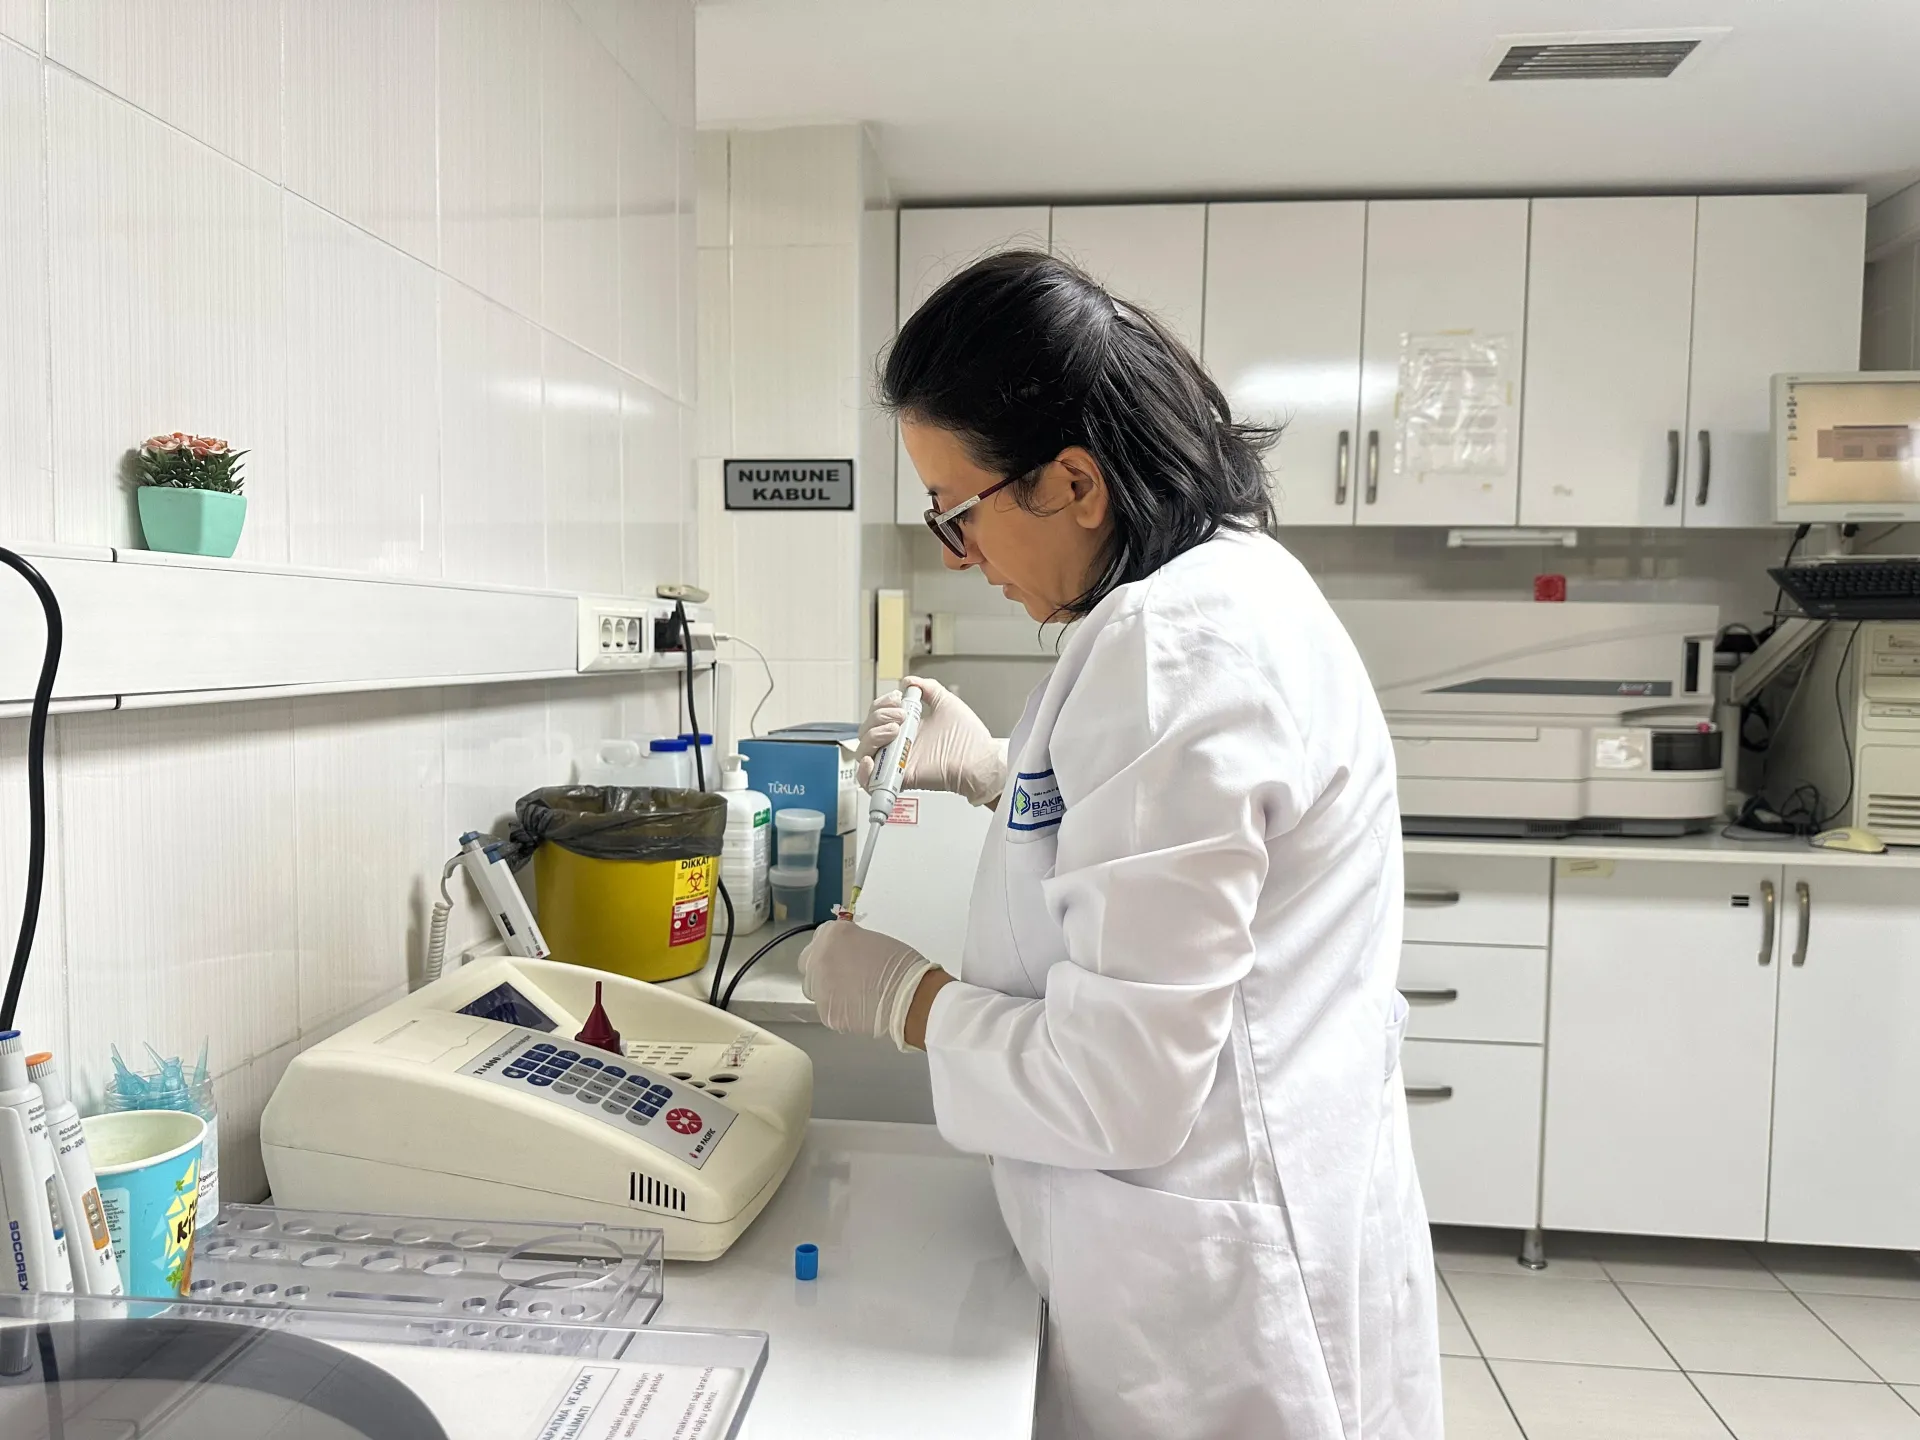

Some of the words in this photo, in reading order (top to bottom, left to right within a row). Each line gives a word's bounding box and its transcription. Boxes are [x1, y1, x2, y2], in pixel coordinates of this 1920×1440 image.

[738, 469, 839, 482] NUMUNE
[752, 487, 830, 501] KABUL
[840, 768, 856, 780] TES
[768, 780, 805, 795] TÜRKLAB
[681, 856, 710, 869] DİKKAT
[694, 1144, 704, 1154] MD
[700, 1127, 716, 1146] PACIFIC
[9, 1219, 30, 1292] SOCOREX
[564, 1396, 580, 1406] VE
[572, 1374, 594, 1396] AÇMA
[691, 1413, 709, 1432] doğru
